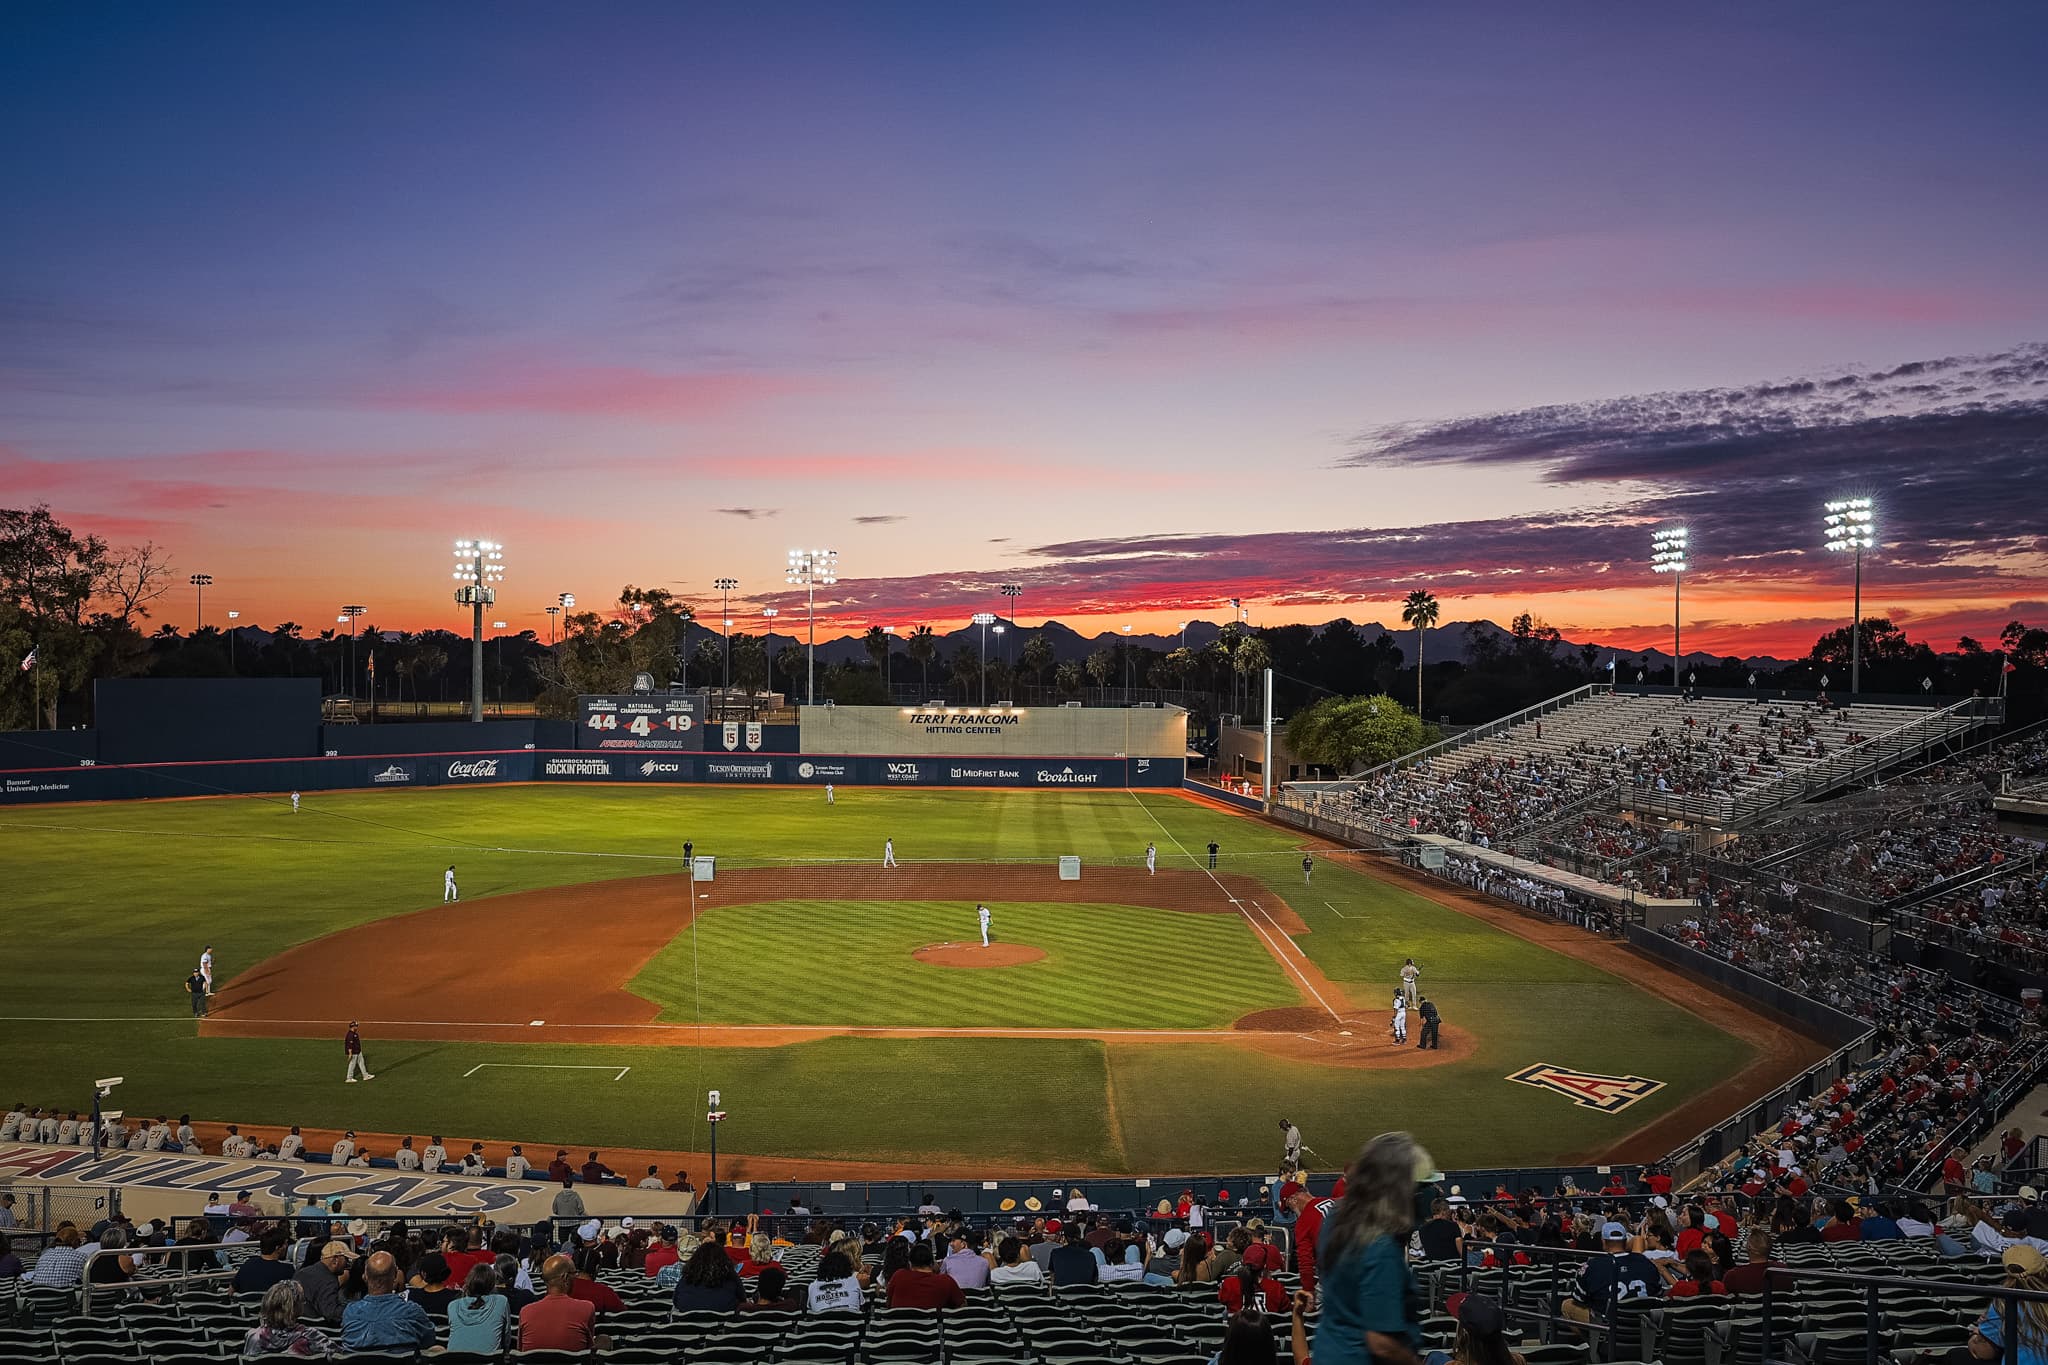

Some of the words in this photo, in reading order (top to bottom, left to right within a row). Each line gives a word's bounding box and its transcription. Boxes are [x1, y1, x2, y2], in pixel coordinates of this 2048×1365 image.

[588, 714, 617, 730] 44
[667, 715, 692, 731] 19
[909, 714, 948, 725] TERRY
[949, 714, 1019, 725] FRANCONA
[630, 715, 651, 737] 4
[926, 726, 963, 734] HITTING
[965, 726, 1001, 734] CENTER
[726, 733, 735, 744] 15
[748, 733, 759, 744] 32
[80, 759, 96, 767] 392
[448, 759, 500, 778] Coca-Cola
[655, 764, 679, 772] ICCU
[709, 764, 731, 773] TUCSON
[576, 764, 609, 775] PROTEIN
[1037, 770, 1068, 782] Coors
[1069, 774, 1098, 782] LIGHT
[6, 785, 40, 793] University
[40, 783, 70, 791] Medicine
[1504, 1062, 1668, 1115] A
[150, 1130, 161, 1139] 27
[510, 1163, 516, 1172] 2
[38, 1150, 547, 1213] WILDCATS
